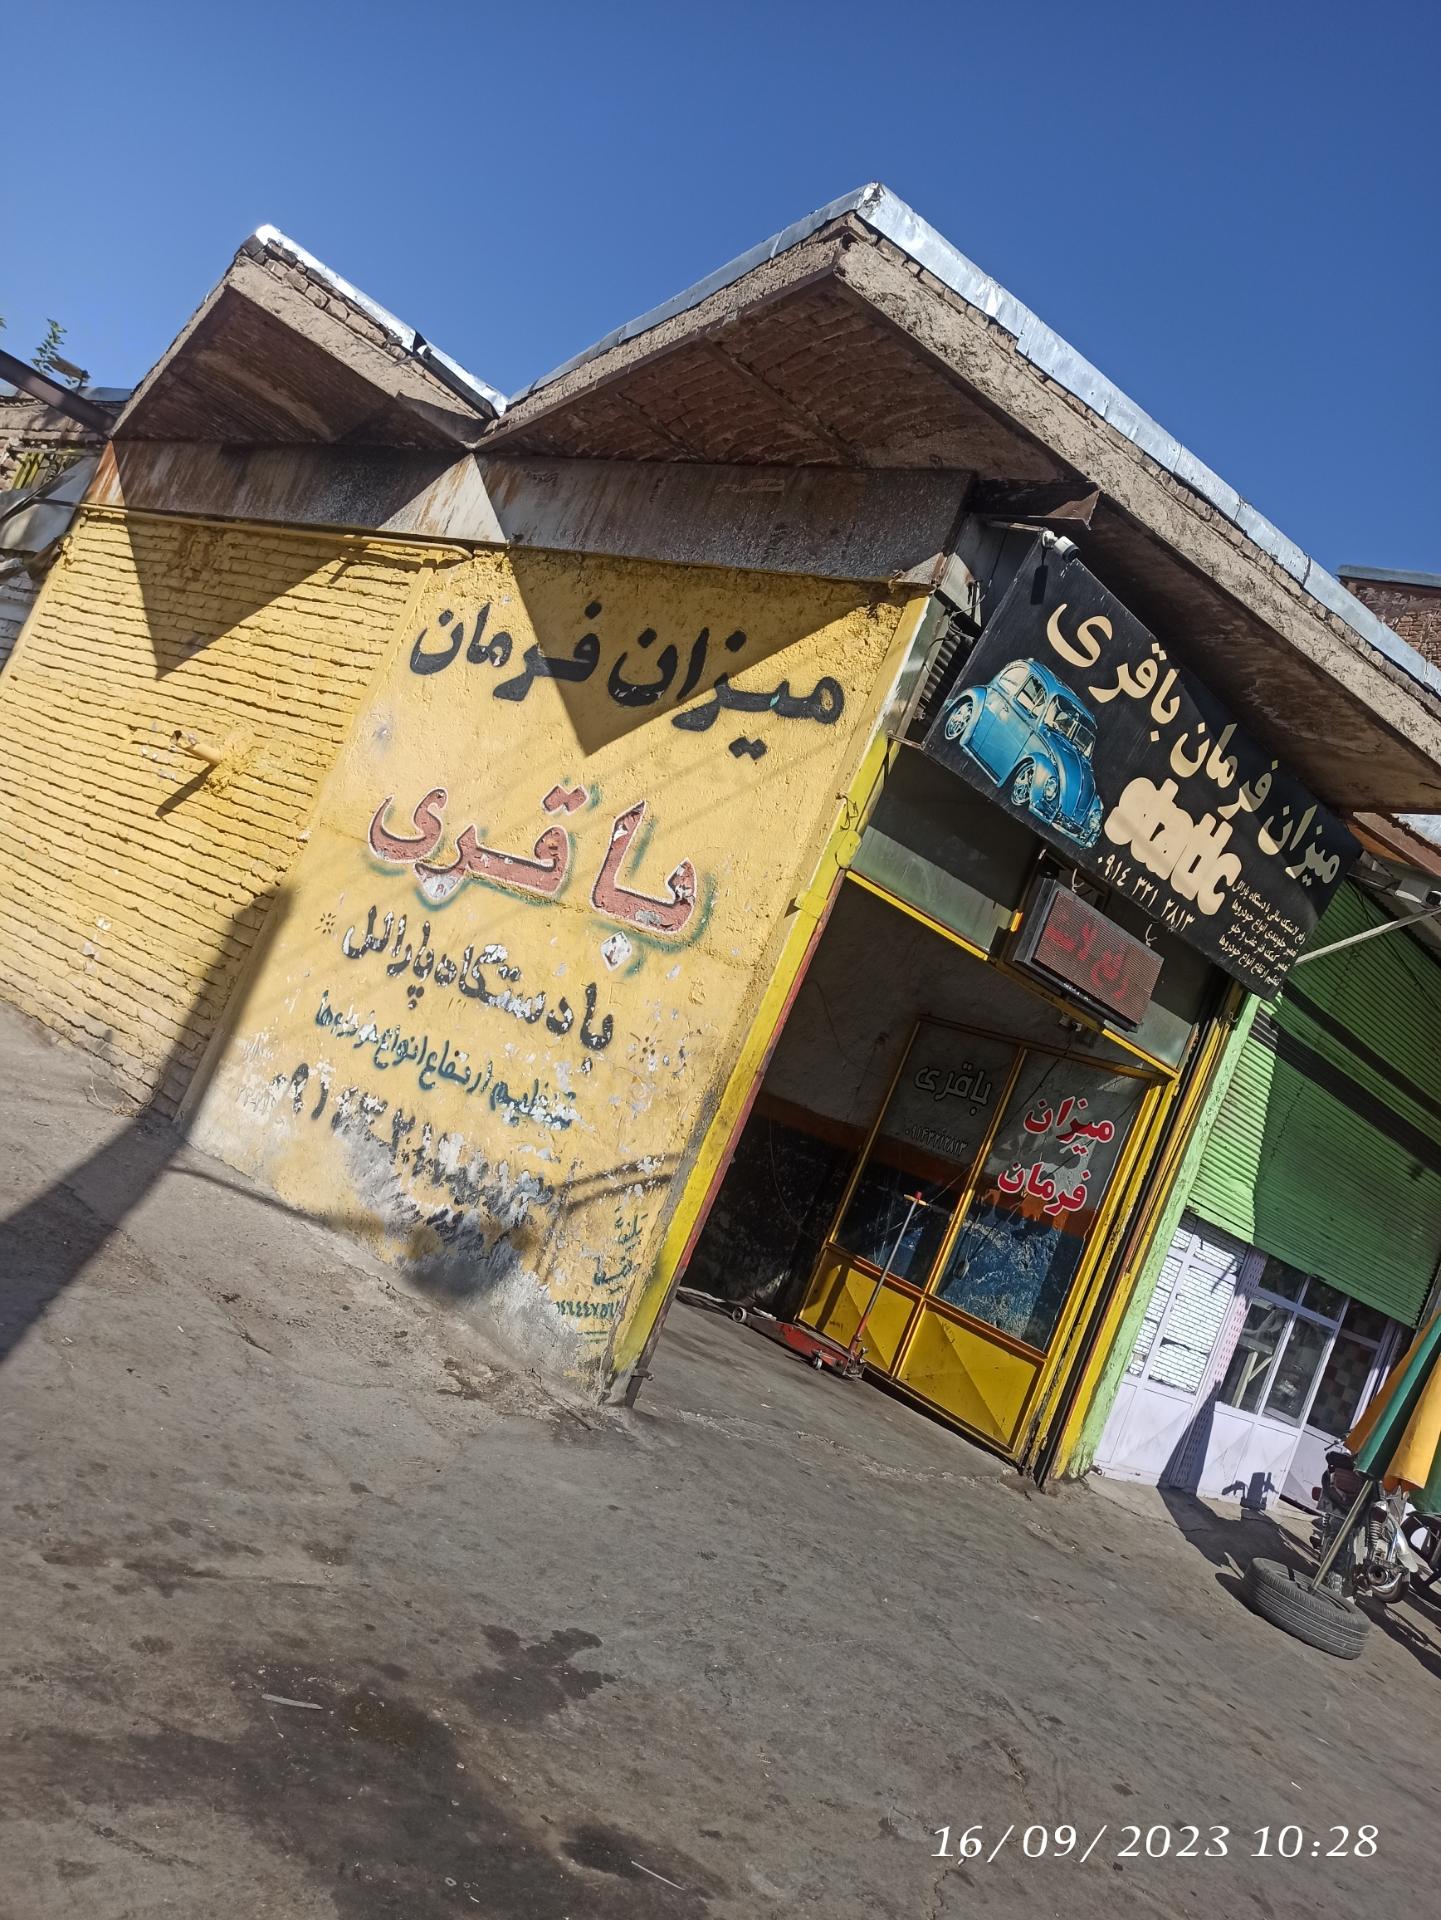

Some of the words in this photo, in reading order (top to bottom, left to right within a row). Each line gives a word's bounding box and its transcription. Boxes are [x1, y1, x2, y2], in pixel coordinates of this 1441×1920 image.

[409, 600, 602, 701] فرمان
[608, 626, 845, 759] میزان
[1047, 603, 1181, 741] باقری
[1169, 721, 1279, 819] فرمان
[1258, 805, 1340, 888] میزان
[434, 943, 574, 1035] دستگاه
[580, 982, 613, 1072] با
[914, 1062, 993, 1115] باقری
[1023, 1096, 1115, 1155] میزان
[998, 1162, 1091, 1216] فرمان
